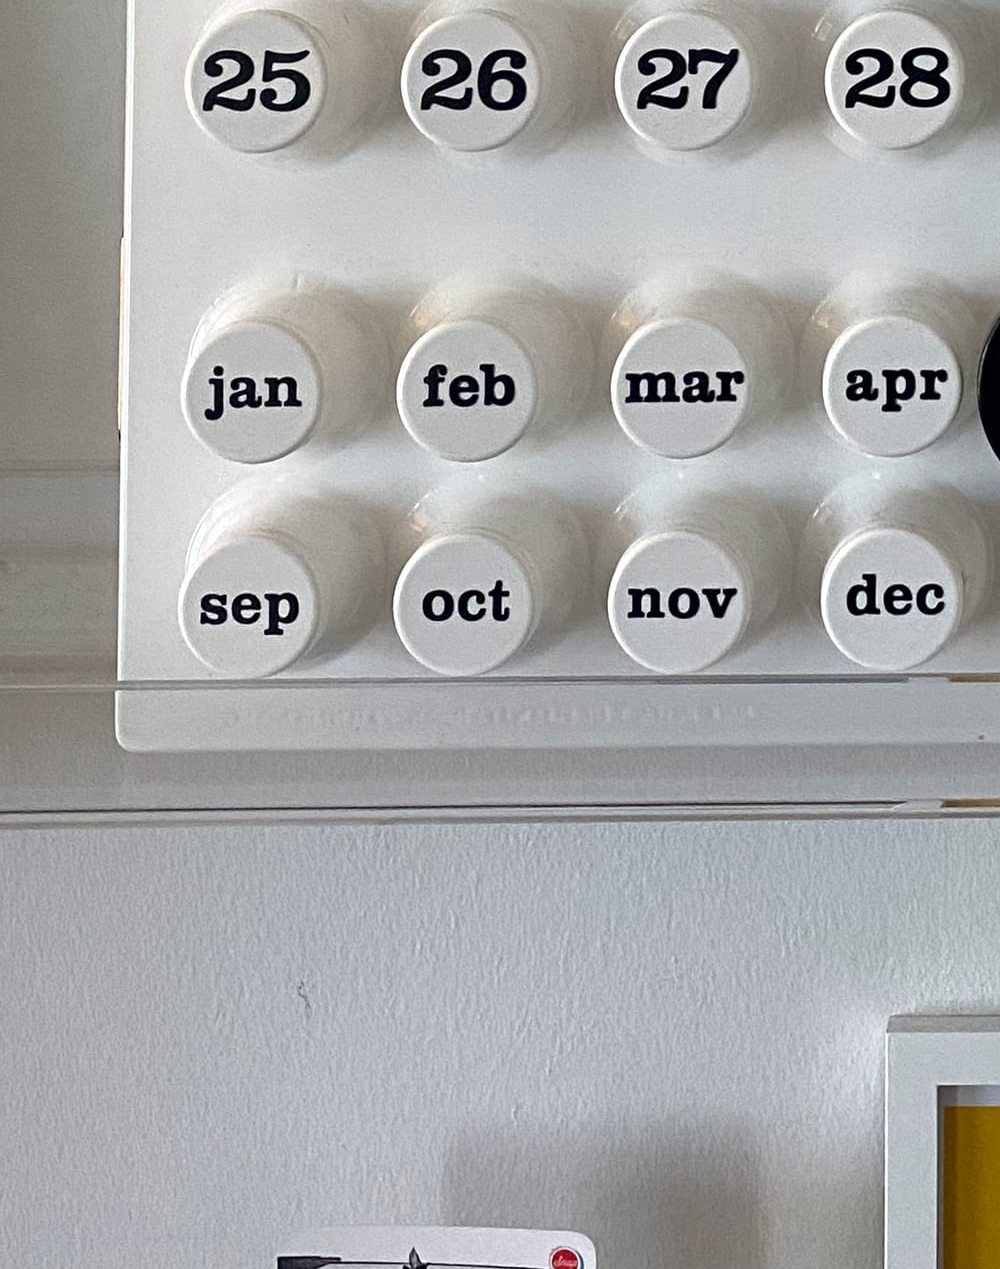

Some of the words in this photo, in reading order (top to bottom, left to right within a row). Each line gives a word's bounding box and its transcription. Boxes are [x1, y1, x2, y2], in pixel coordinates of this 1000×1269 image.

[202, 49, 311, 113] 25
[420, 48, 527, 112] 26
[636, 48, 740, 110] 27
[844, 46, 951, 109] 28
[204, 365, 303, 421] jan
[422, 363, 516, 408] feb
[624, 370, 745, 404] mar
[845, 368, 949, 413] apr
[199, 592, 300, 636] sep
[422, 579, 511, 622] oct
[627, 587, 738, 620] nov
[846, 573, 946, 617] dec
